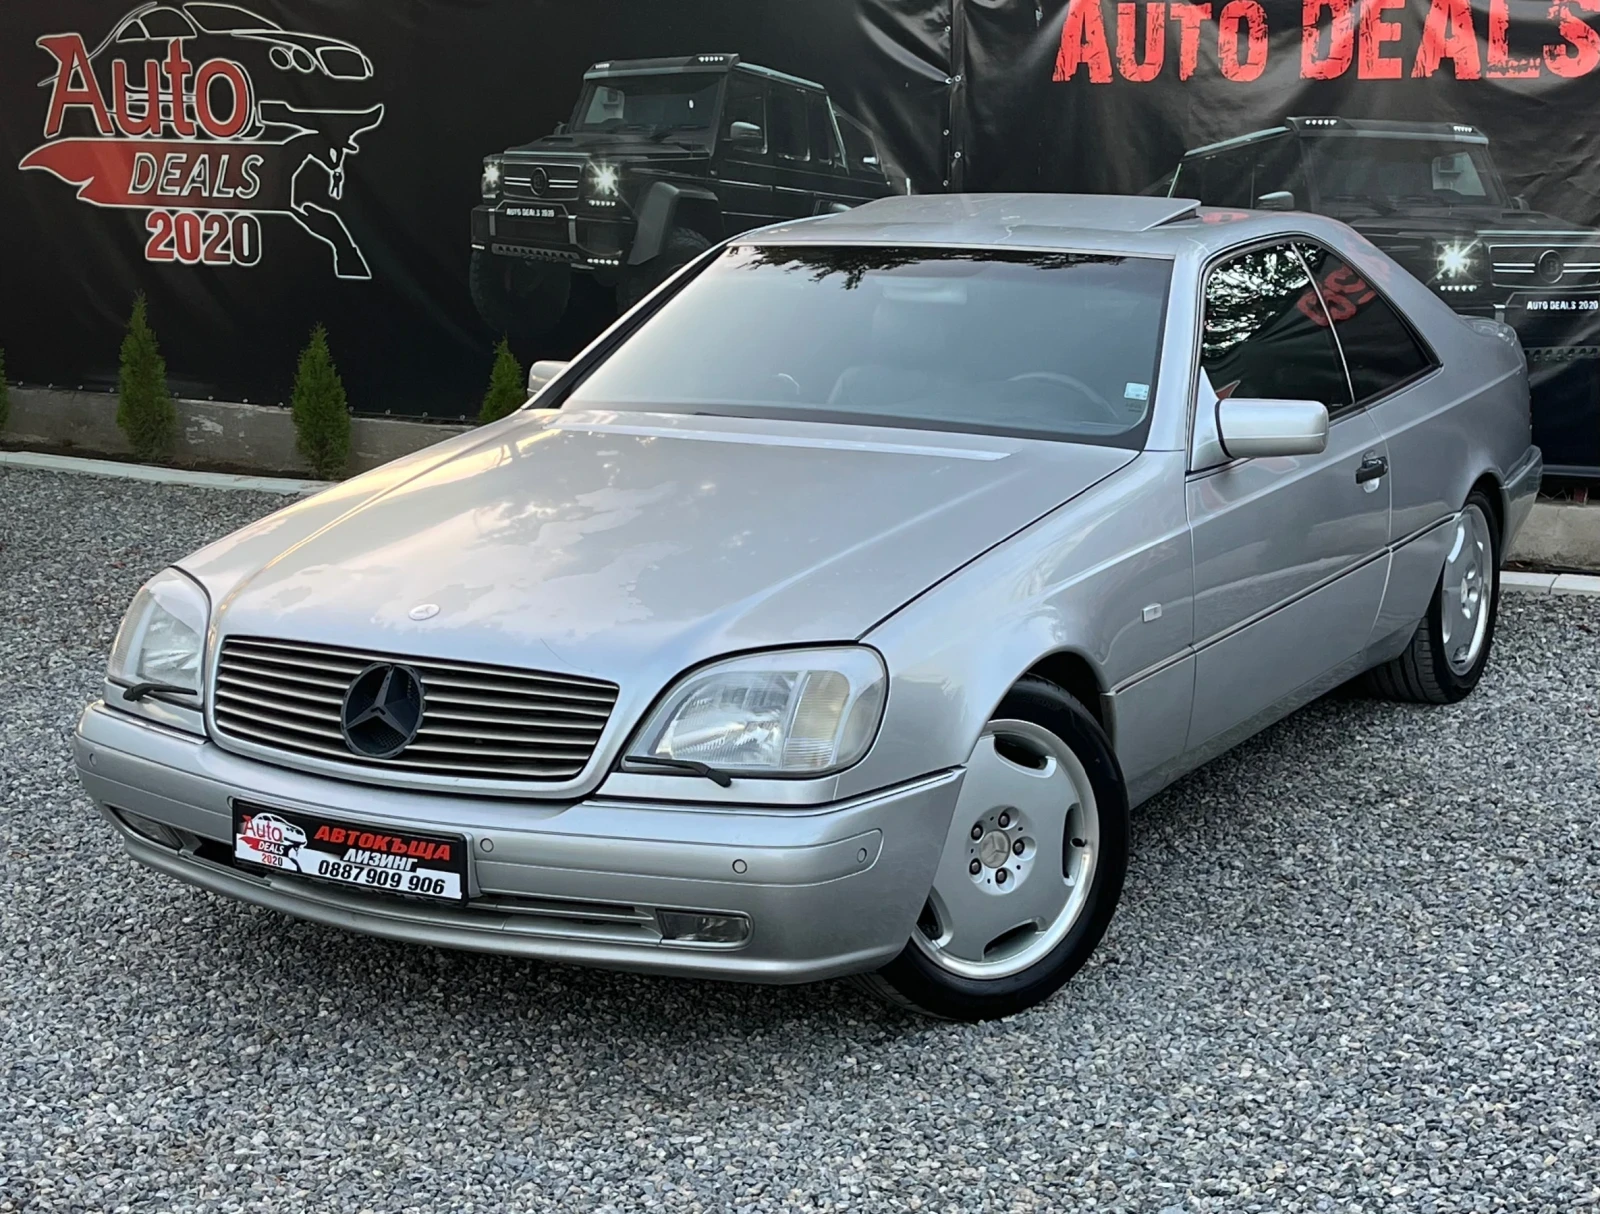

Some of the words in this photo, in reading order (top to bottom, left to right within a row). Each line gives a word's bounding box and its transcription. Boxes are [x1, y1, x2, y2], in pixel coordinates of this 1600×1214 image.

[1052, 0, 1269, 84] AUTO
[1300, 0, 1600, 80] DEALS
[36, 33, 253, 138] Auto
[127, 152, 264, 199] DEALS
[145, 210, 261, 265] 2020
[1527, 301, 1548, 310] AUTO
[1550, 301, 1577, 310] DEALS
[1578, 300, 1599, 310] 2020
[242, 815, 284, 843] Auto
[314, 825, 451, 861] АВТОКЪЩА
[258, 841, 285, 855] DEALS
[261, 853, 284, 867] 2020
[342, 848, 418, 872] ЛИЗИНГ
[318, 860, 365, 882] 0887
[365, 868, 403, 888] 909
[408, 875, 446, 895] 906
